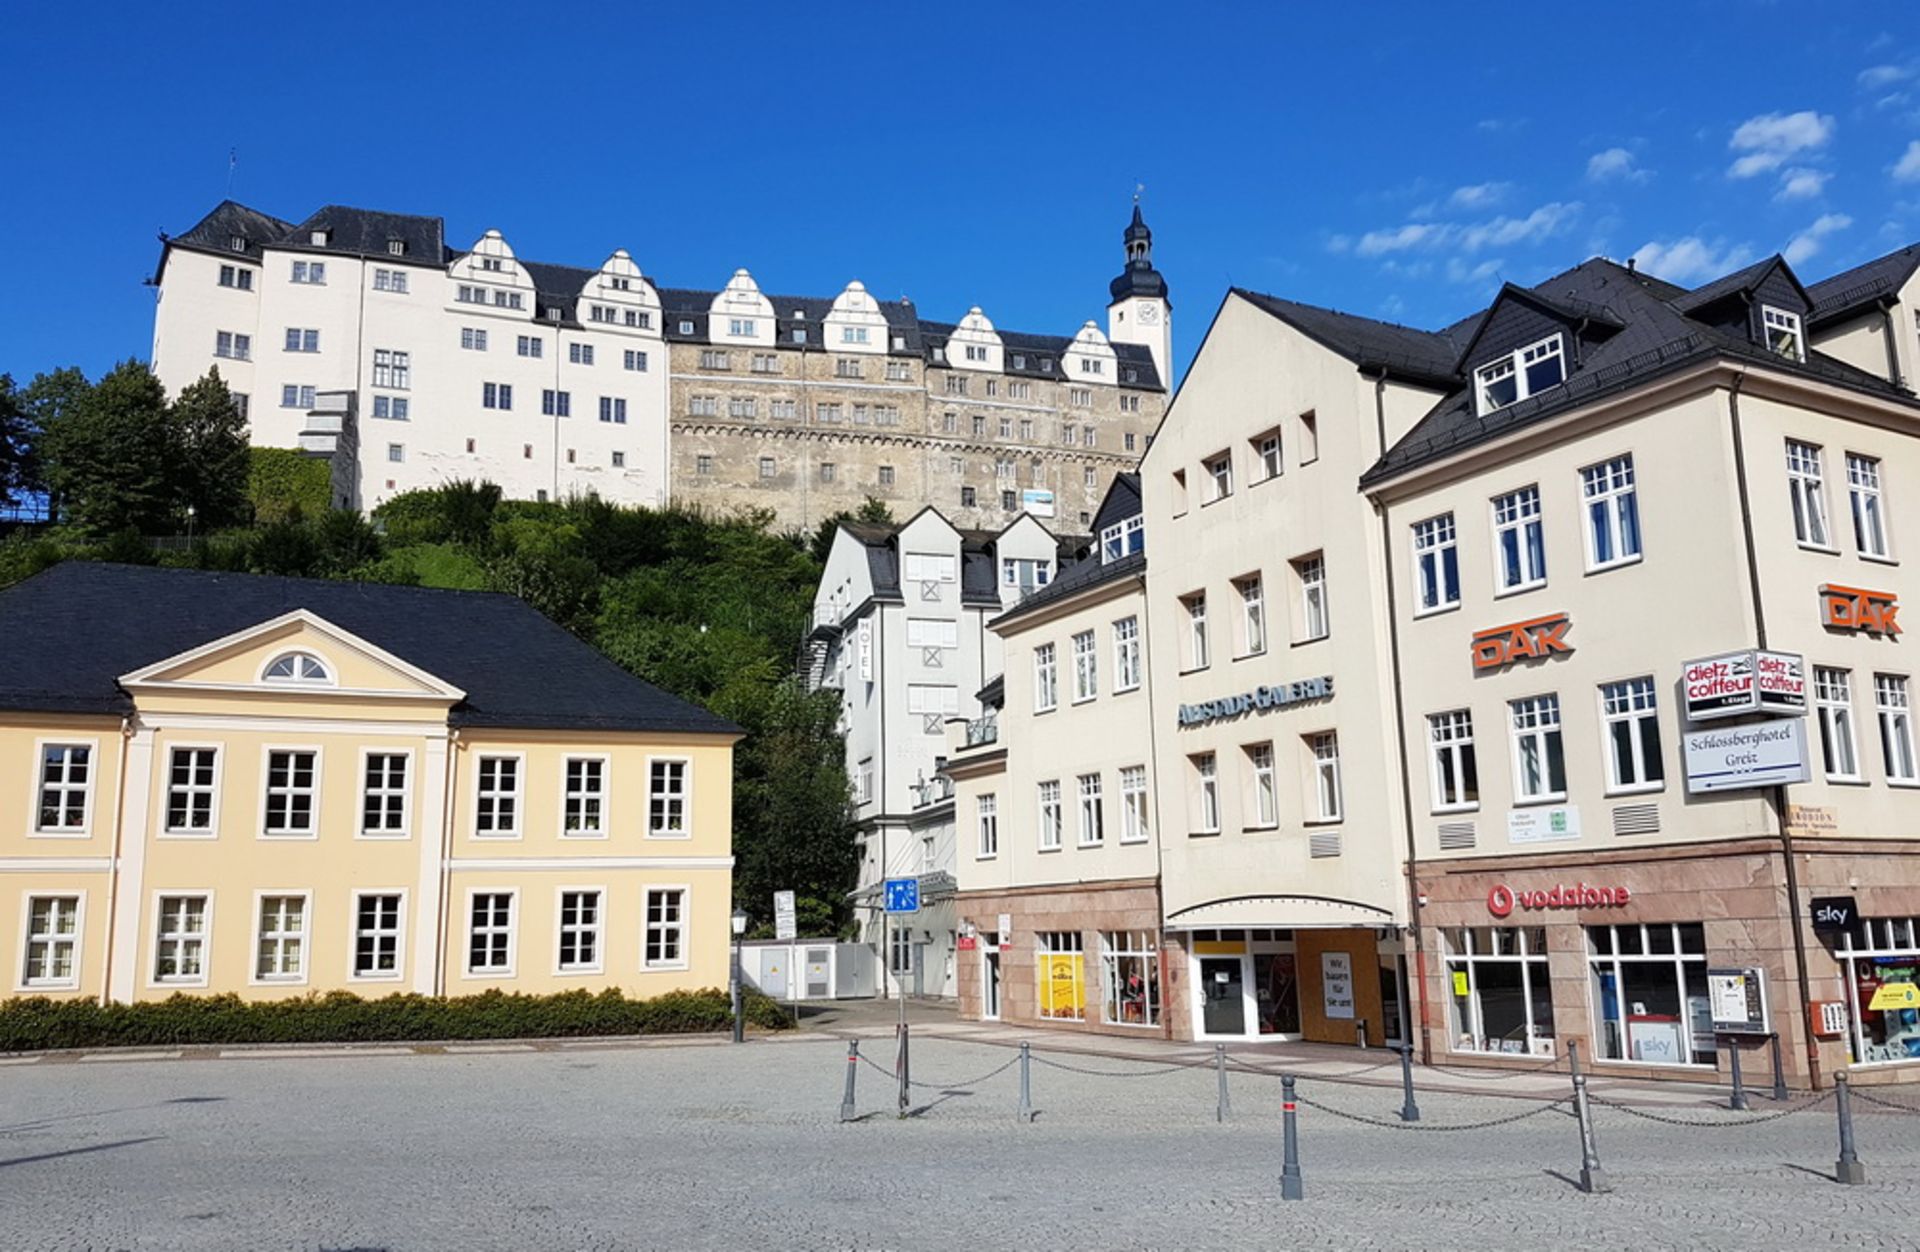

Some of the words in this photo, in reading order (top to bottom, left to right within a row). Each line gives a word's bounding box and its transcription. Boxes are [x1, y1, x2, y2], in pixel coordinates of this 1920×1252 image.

[1821, 583, 1903, 635] DAK
[1472, 611, 1570, 668] DAK
[860, 622, 870, 679] HOTEL
[1687, 662, 1729, 682] dietz
[1758, 657, 1786, 675] dietz
[1688, 677, 1753, 698] coiffeur
[1760, 675, 1804, 693] coiffeur
[1690, 724, 1791, 751] Schlossberghotel
[1725, 751, 1759, 767] Greiz
[1519, 882, 1630, 907] vodafone
[1816, 905, 1848, 924] sky
[1643, 1036, 1671, 1056] sky
